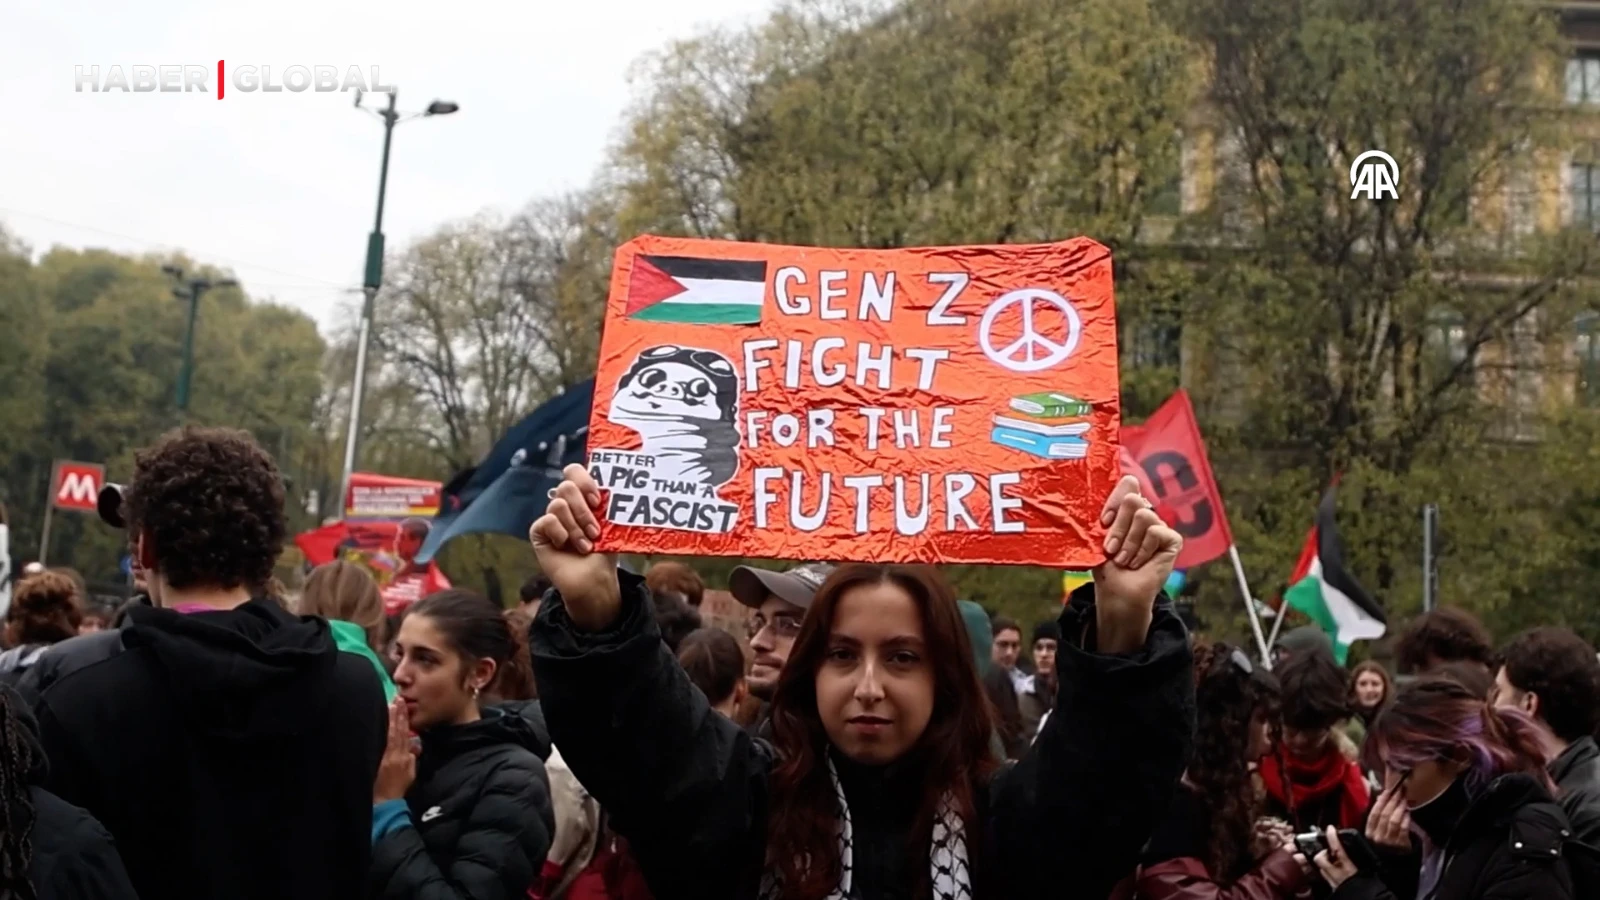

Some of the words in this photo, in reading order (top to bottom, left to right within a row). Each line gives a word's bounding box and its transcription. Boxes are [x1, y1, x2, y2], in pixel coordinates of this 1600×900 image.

[774, 266, 896, 322] GEN
[926, 272, 970, 326] Z
[743, 337, 950, 392] FIGHT
[746, 408, 836, 449] FOR
[859, 406, 955, 450] THE
[591, 452, 656, 468] BETTER
[58, 471, 97, 505] M
[589, 465, 604, 487] A
[609, 465, 650, 489] PIG
[652, 478, 698, 495] THAN
[701, 485, 715, 499] A
[753, 467, 1027, 535] FUTURE
[608, 493, 739, 533] FASCIST
